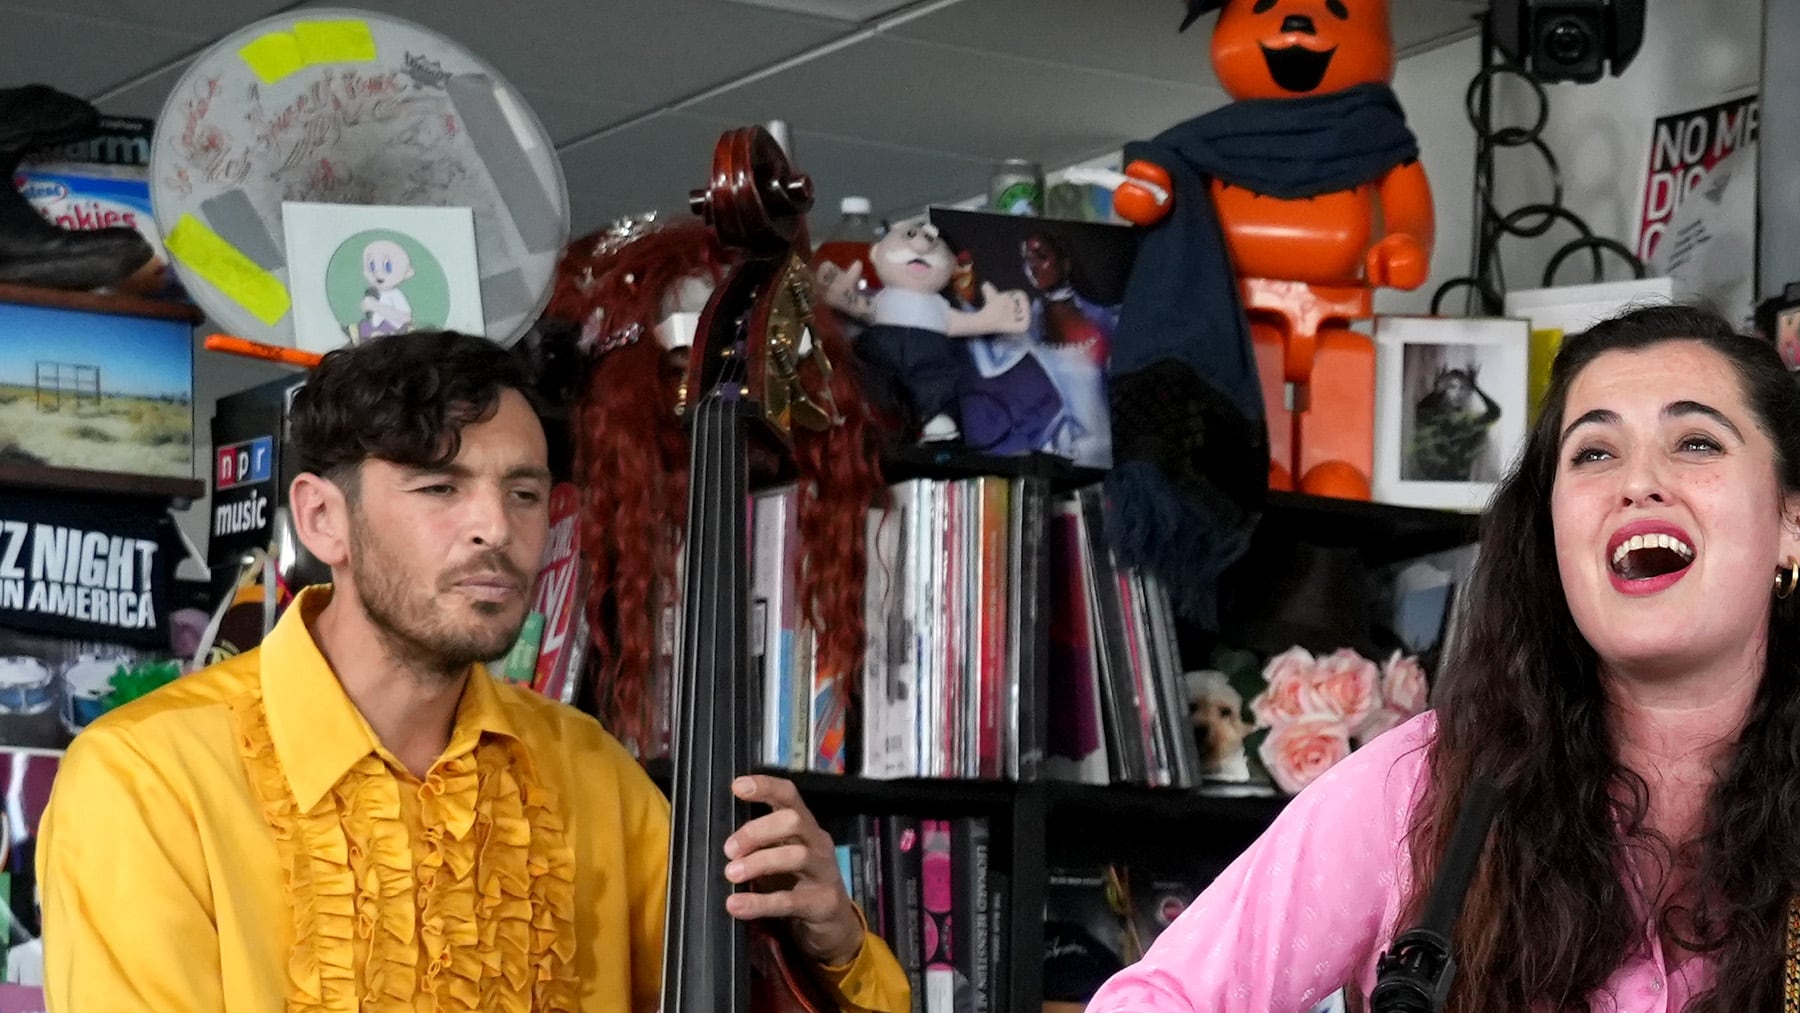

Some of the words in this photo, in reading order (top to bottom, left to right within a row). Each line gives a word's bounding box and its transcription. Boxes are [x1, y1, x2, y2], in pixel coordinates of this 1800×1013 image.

[1655, 116, 1708, 171] NO
[221, 444, 265, 481] npr
[215, 489, 267, 537] music
[33, 523, 158, 593] NIGHT
[27, 580, 156, 629] AMERICA
